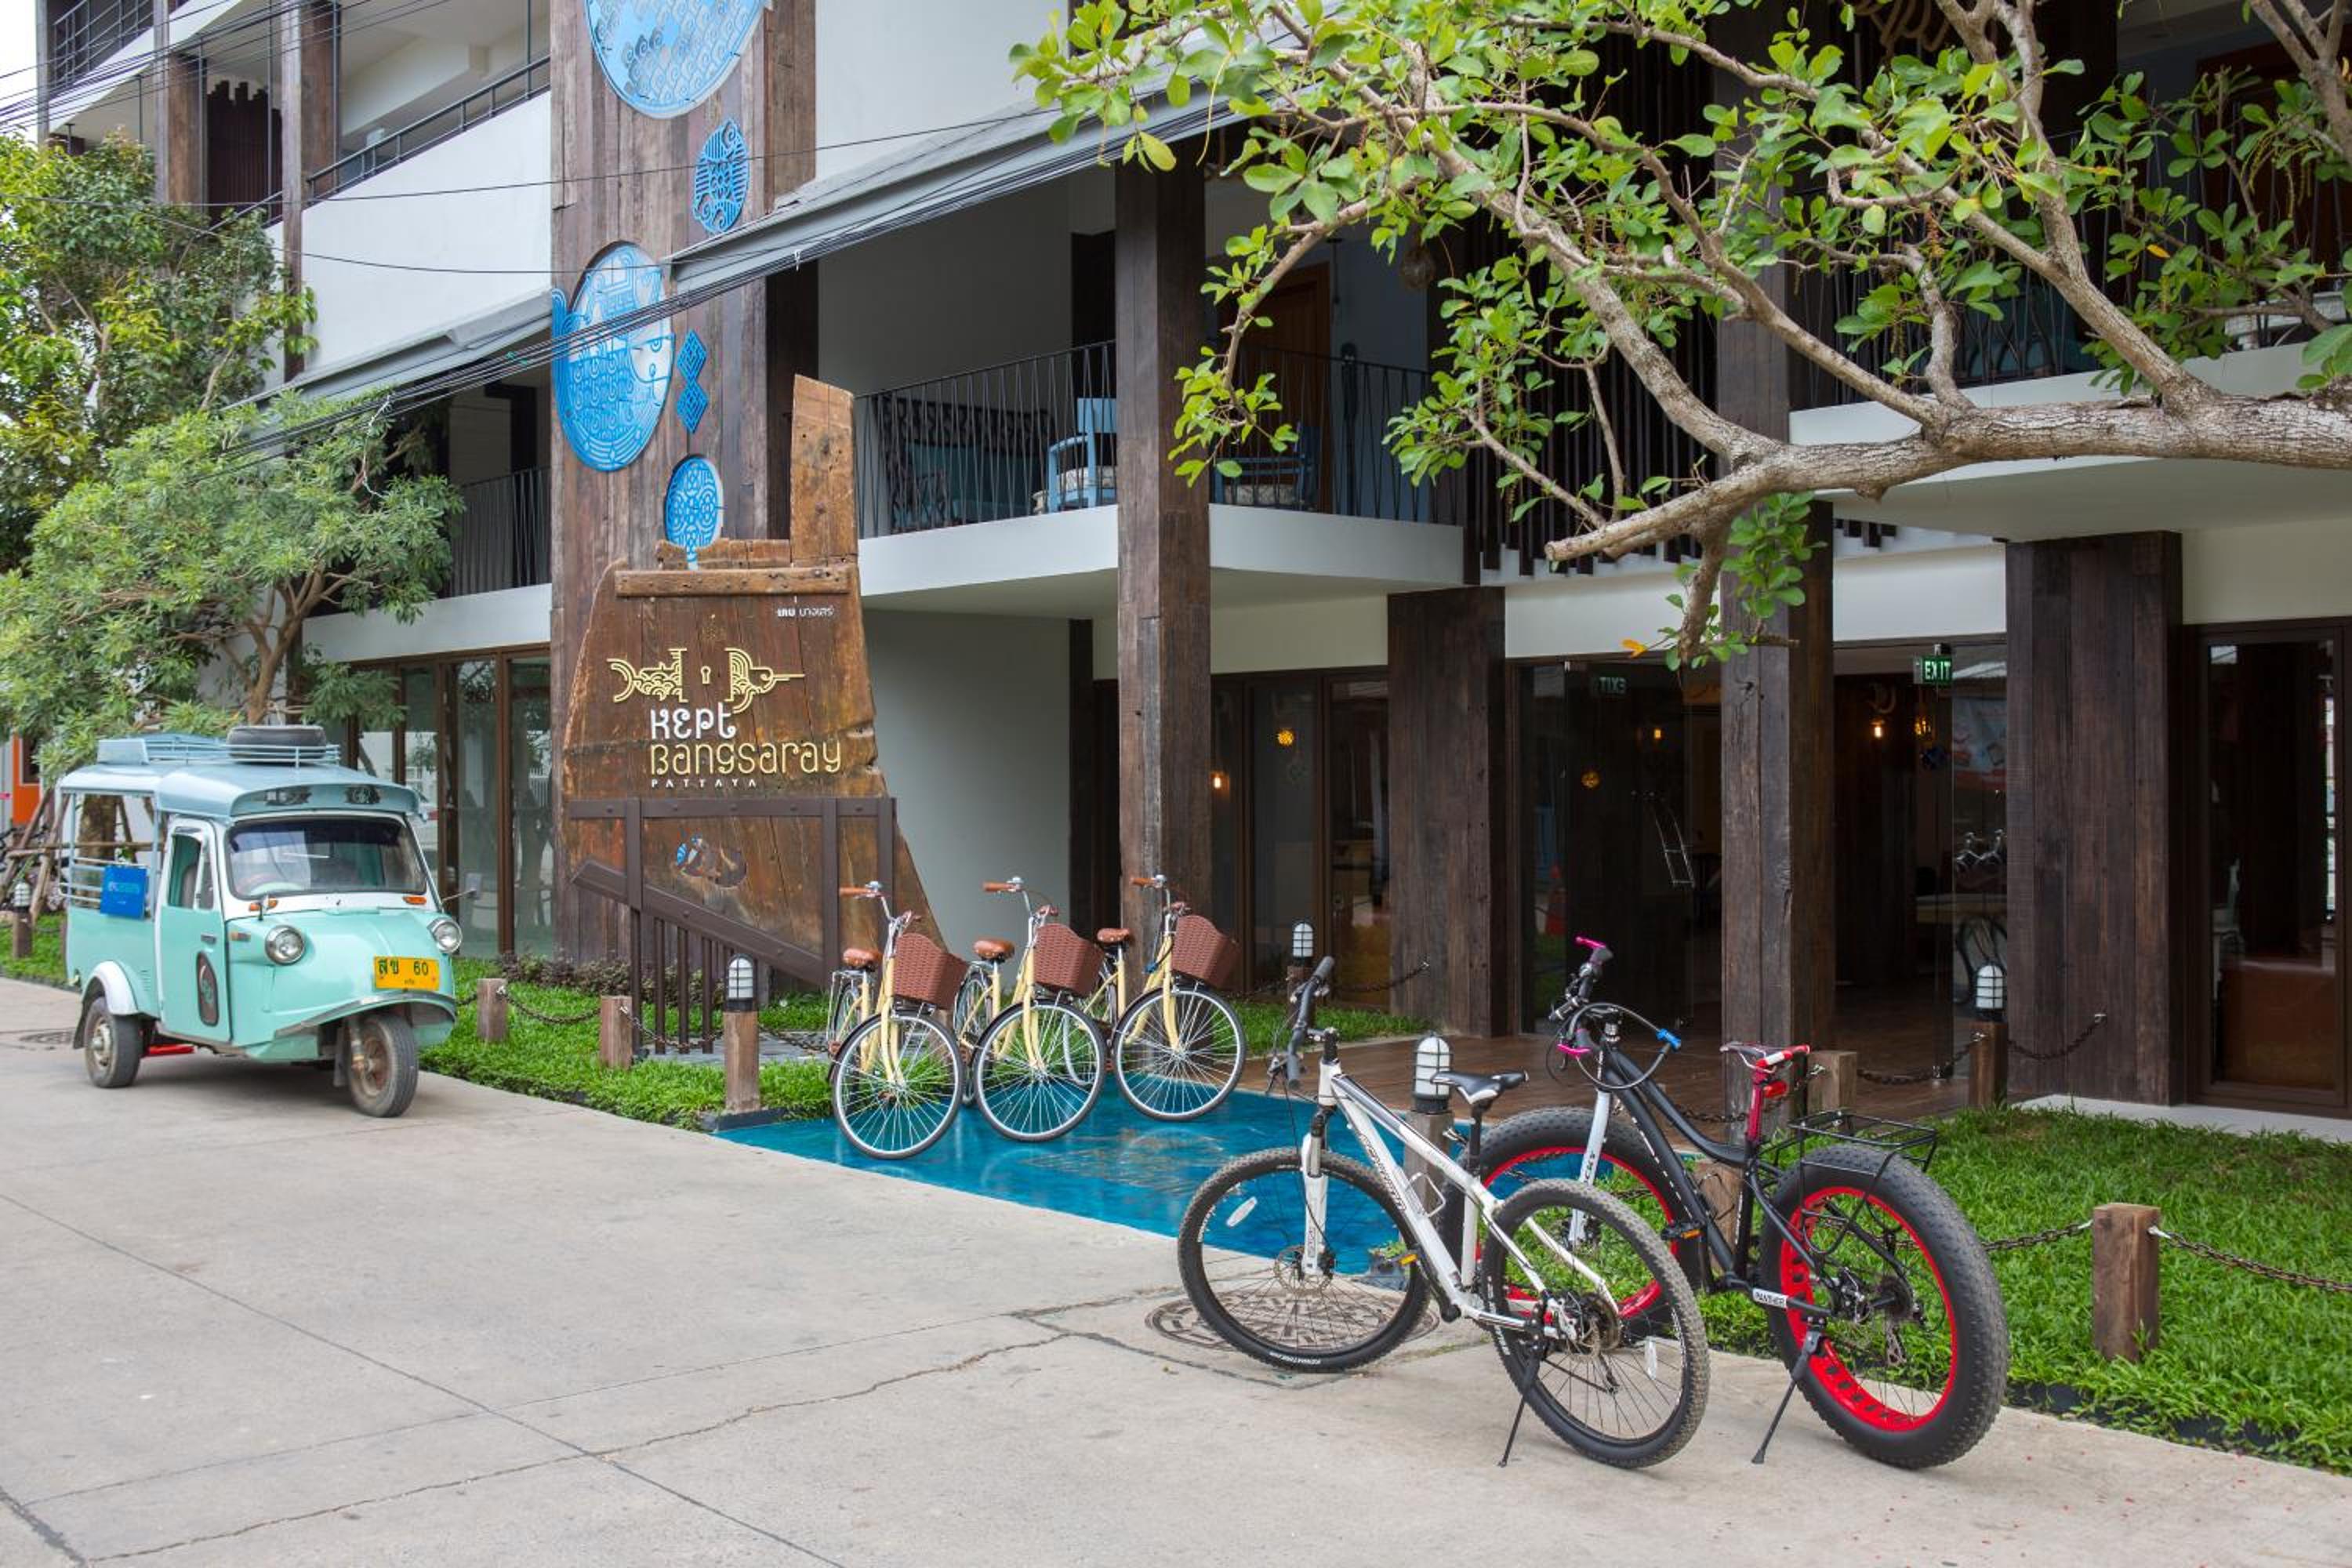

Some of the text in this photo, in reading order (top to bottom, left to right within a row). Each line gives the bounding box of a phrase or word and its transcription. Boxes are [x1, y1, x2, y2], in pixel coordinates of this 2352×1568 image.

[1924, 660, 1951, 681] EXIT
[650, 742, 842, 775] Bangsaray
[651, 779, 758, 788] PATTAYA
[412, 960, 429, 976] 60
